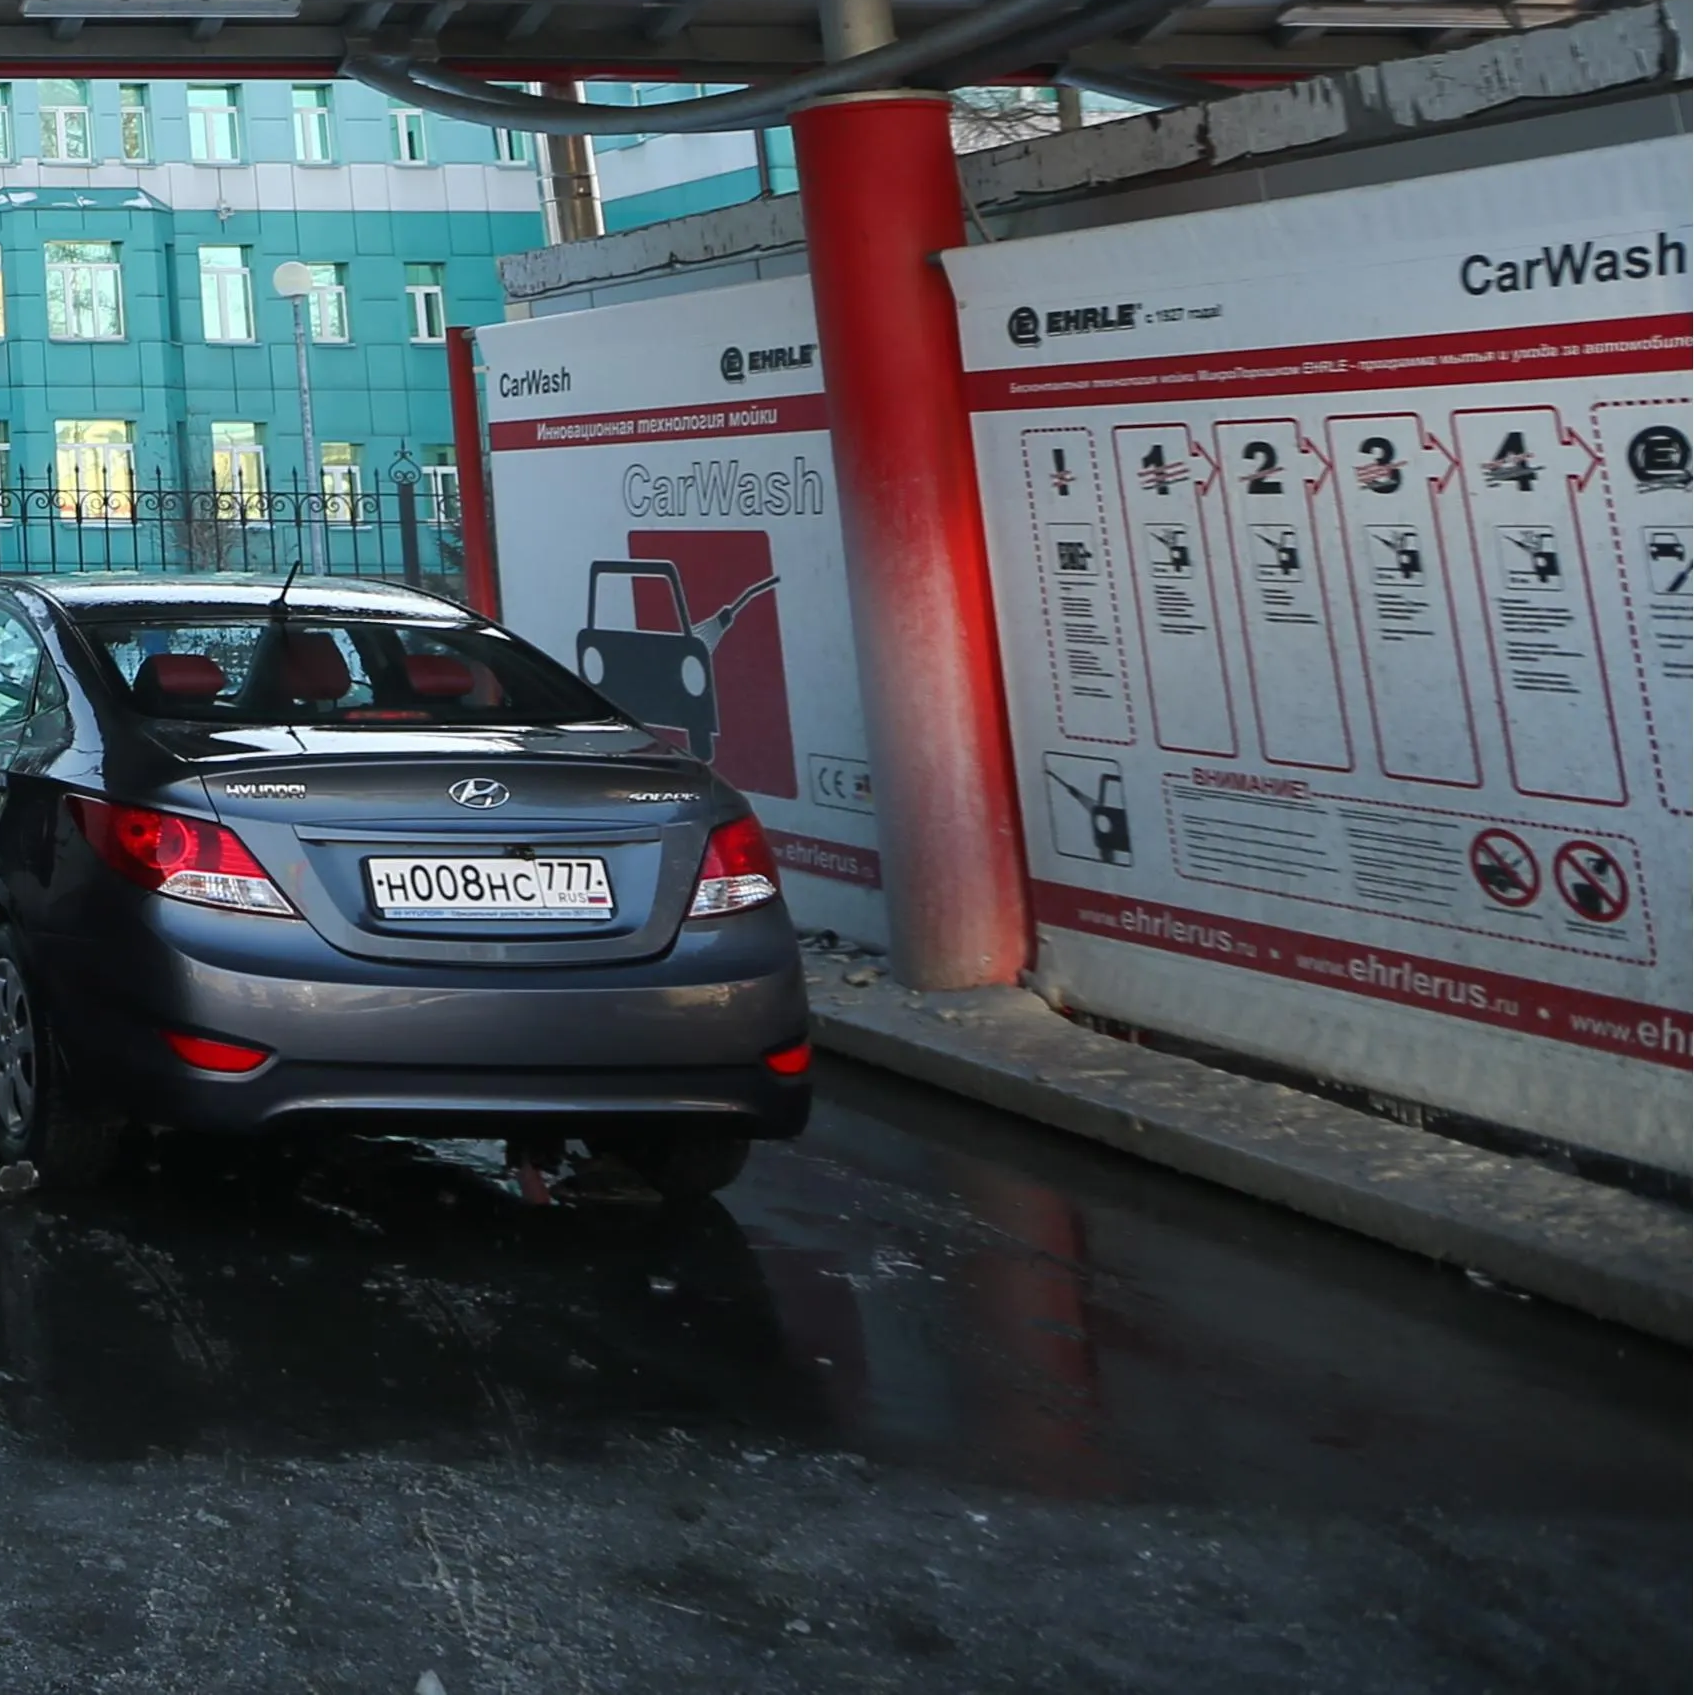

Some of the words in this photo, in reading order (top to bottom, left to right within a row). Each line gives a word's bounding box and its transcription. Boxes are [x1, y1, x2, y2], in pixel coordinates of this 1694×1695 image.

[1461, 232, 1687, 296] CarWash
[1046, 304, 1135, 336] EHRLE
[748, 345, 814, 371] EHRLE
[499, 366, 572, 397] CarWash
[536, 422, 634, 441] Инновационная
[637, 413, 725, 433] технология
[728, 405, 778, 427] мойки
[1242, 441, 1284, 495] 2
[1358, 437, 1402, 494] 3
[1484, 432, 1538, 492] 4
[623, 456, 824, 517] CarWash
[224, 784, 306, 798] HYUNDAI
[538, 862, 592, 890] 777
[559, 892, 586, 903] RUS
[1295, 954, 1519, 1017] www.ehrlerus.ru
[1569, 1012, 1693, 1057] www.eh
